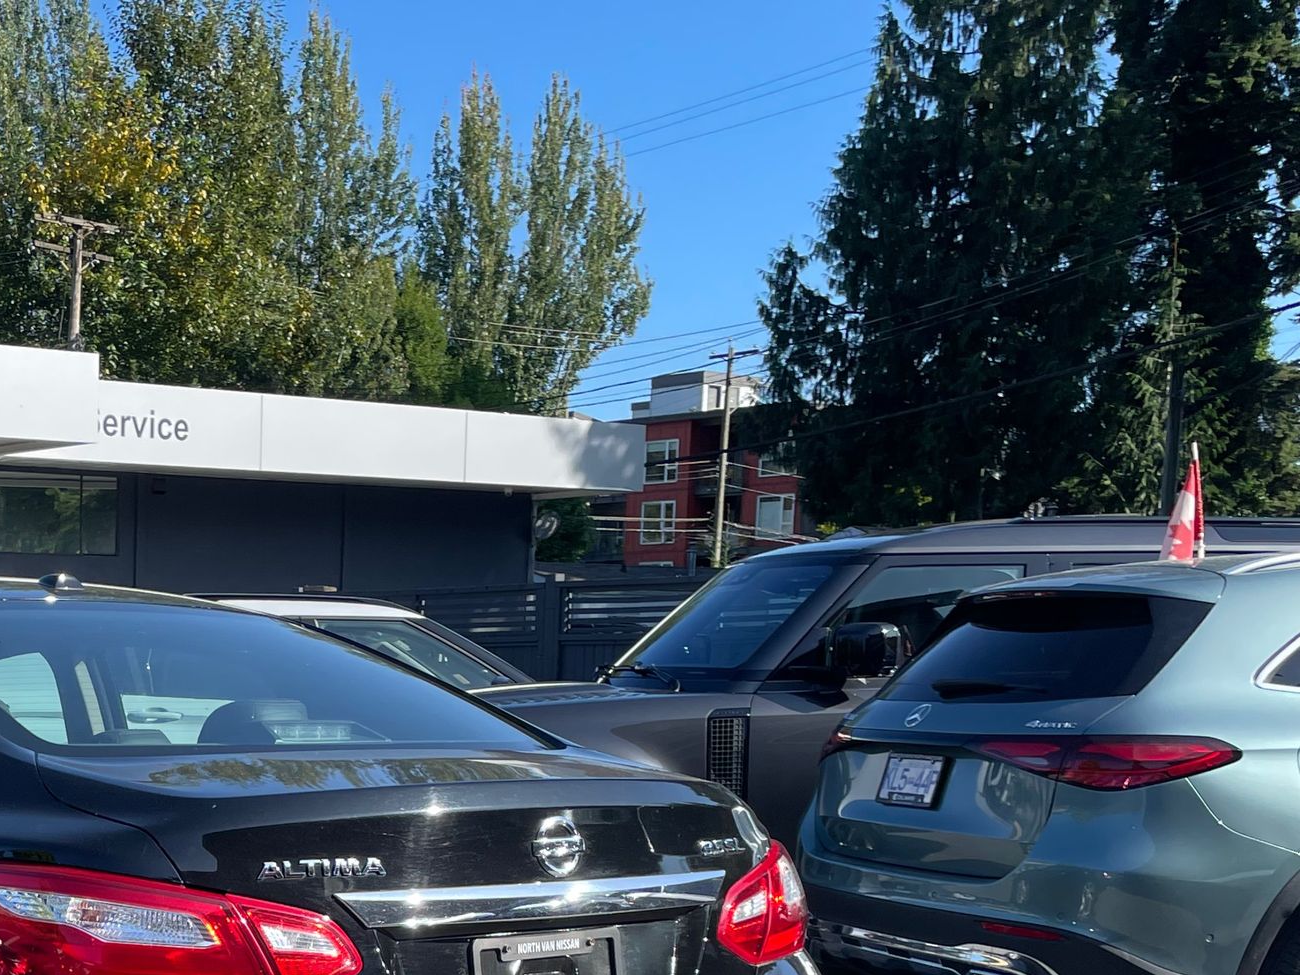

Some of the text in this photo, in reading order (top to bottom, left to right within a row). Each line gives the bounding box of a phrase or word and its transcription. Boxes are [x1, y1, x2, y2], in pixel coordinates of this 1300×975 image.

[97, 408, 189, 441] ervice
[256, 857, 387, 880] ALTIMA
[517, 938, 580, 955] NORTH VAN NISSAN
